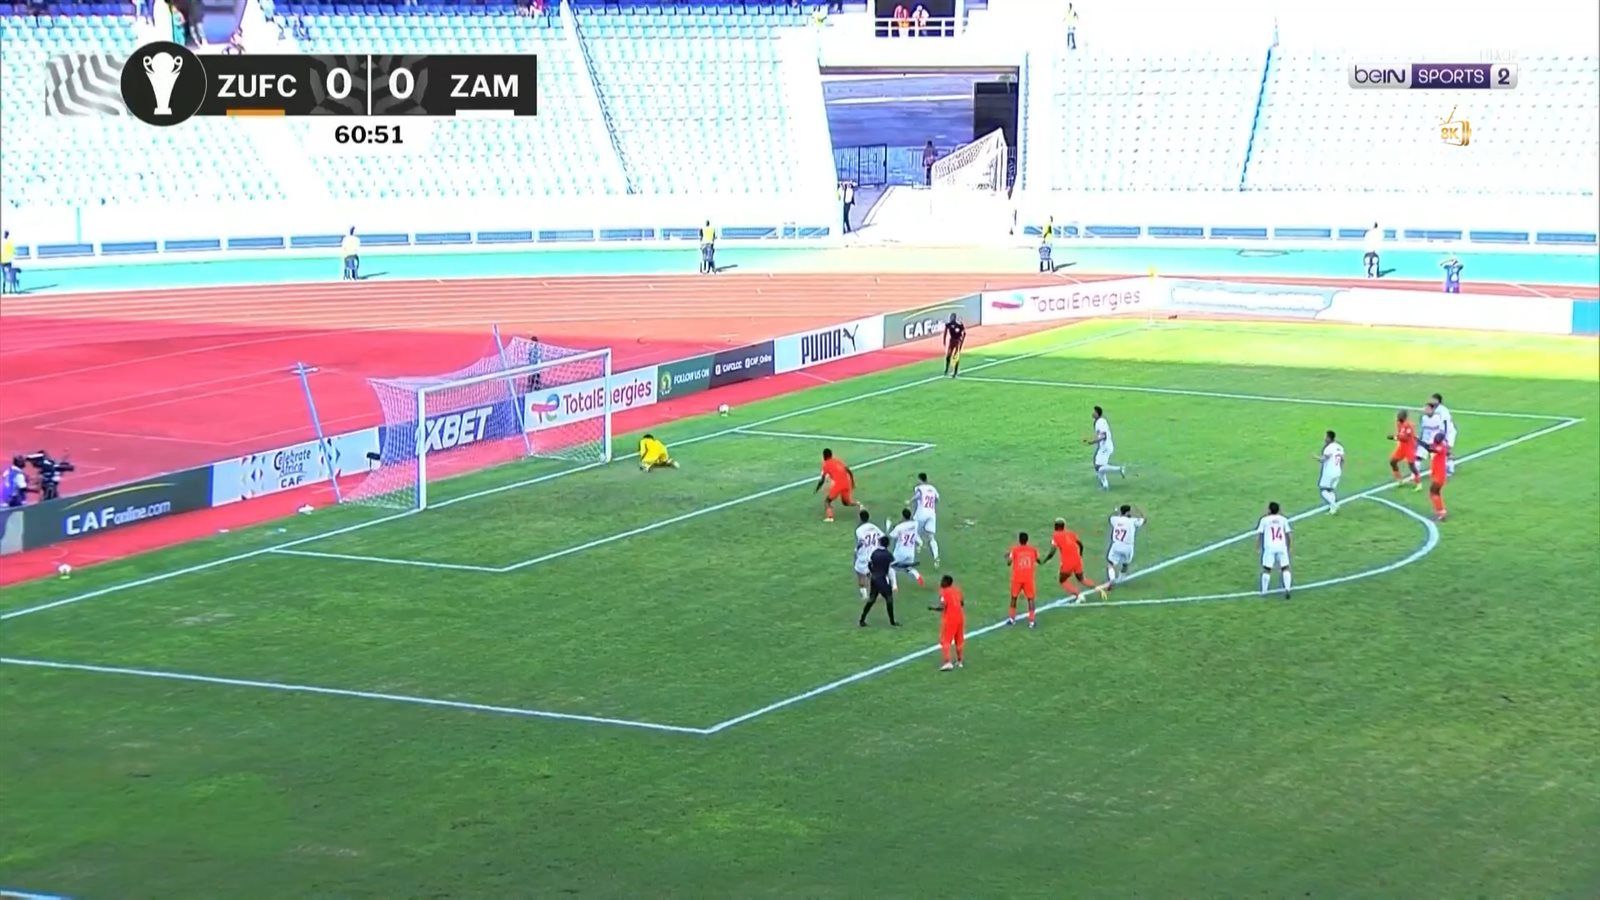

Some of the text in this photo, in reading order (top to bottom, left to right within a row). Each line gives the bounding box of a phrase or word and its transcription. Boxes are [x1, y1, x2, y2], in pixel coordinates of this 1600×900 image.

[1030, 290, 1141, 311] TotalEnergies
[801, 328, 841, 365] PUMA
[274, 449, 311, 471] Celebrate
[281, 475, 303, 488] CAF
[65, 501, 171, 535] CAFonline.com
[1114, 529, 1127, 542] 27
[1270, 526, 1283, 541] 14
